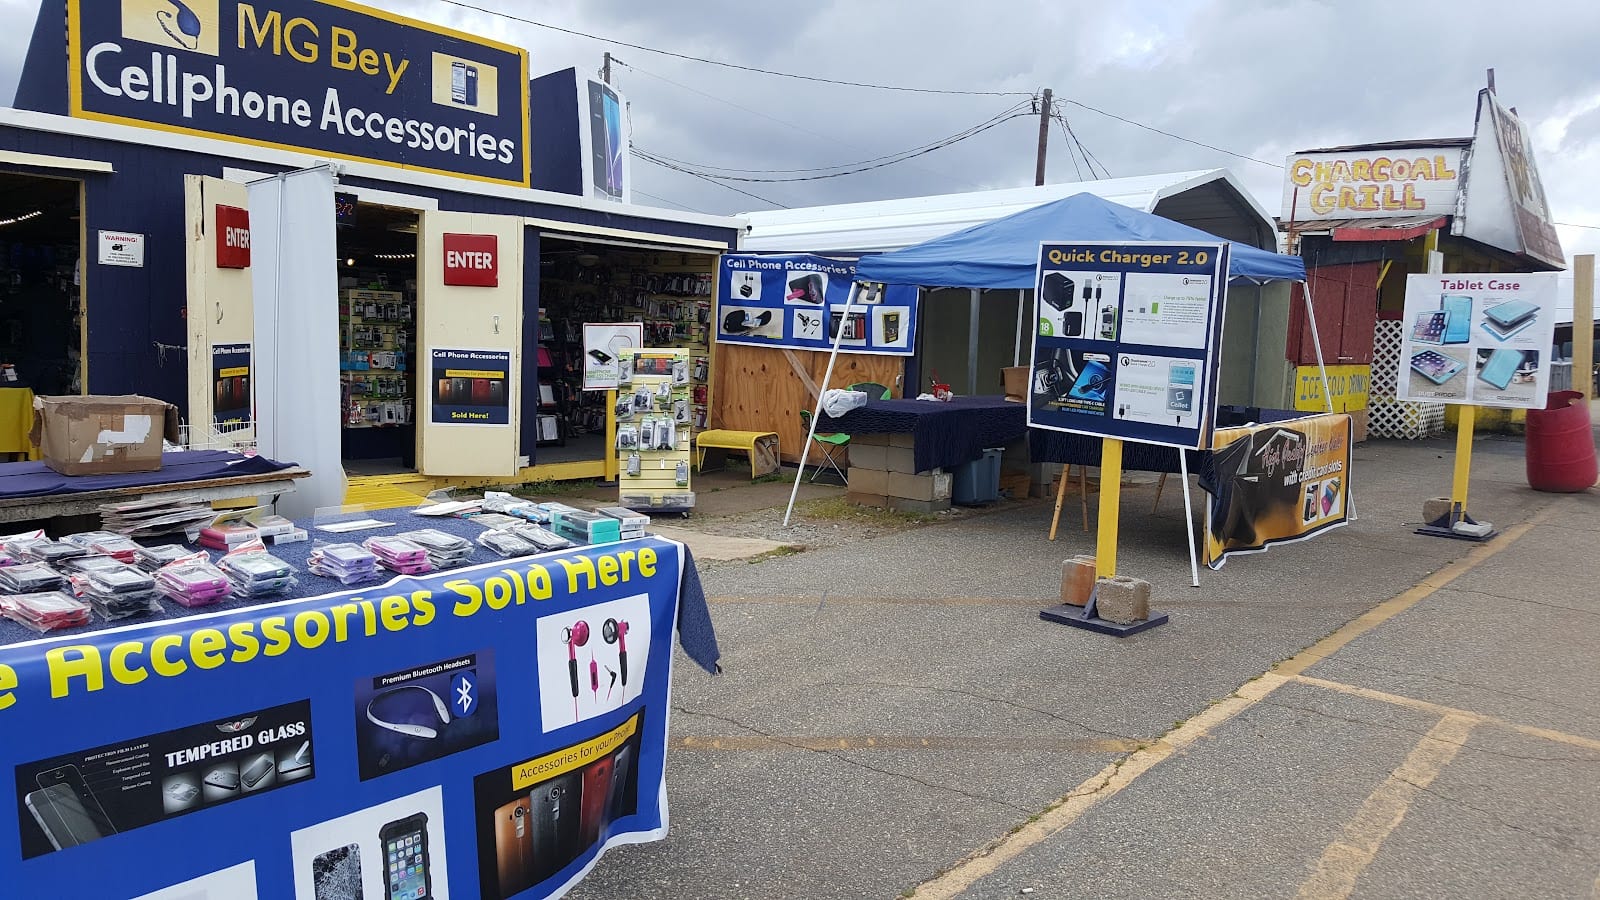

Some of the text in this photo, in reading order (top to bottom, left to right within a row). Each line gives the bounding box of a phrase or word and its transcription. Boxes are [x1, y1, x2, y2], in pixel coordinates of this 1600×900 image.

[238, 2, 409, 95] MG Bey
[85, 42, 515, 165] Cellphone Accessories
[1291, 155, 1456, 187] CHARCOAL
[1310, 182, 1426, 215] GRILL
[105, 234, 138, 243] WARNING!
[226, 226, 250, 249] ENTER
[447, 250, 493, 270] ENTER
[726, 259, 746, 268] Cell
[748, 259, 781, 270] Phone
[785, 261, 847, 274] Accessories
[1048, 249, 1208, 267] Quick Charger 2.0
[1441, 280, 1520, 290] Tablet Case
[1040, 322, 1050, 332] 18
[447, 351, 469, 359] Phone
[1301, 376, 1320, 400] ICE
[1327, 375, 1345, 396] COLD
[1283, 459, 1342, 487] with credit card slots
[45, 589, 436, 698] Accessories
[443, 563, 553, 617] Sold
[557, 547, 658, 593] Here
[382, 659, 471, 685] Premium Bluetooth Headsets
[84, 751, 117, 762] PROTECTION
[130, 743, 149, 751] LAYERS
[165, 721, 306, 768] TEMPERED GLASS
[519, 751, 578, 780] Accessories
[580, 745, 594, 759] for
[595, 736, 613, 753] your
